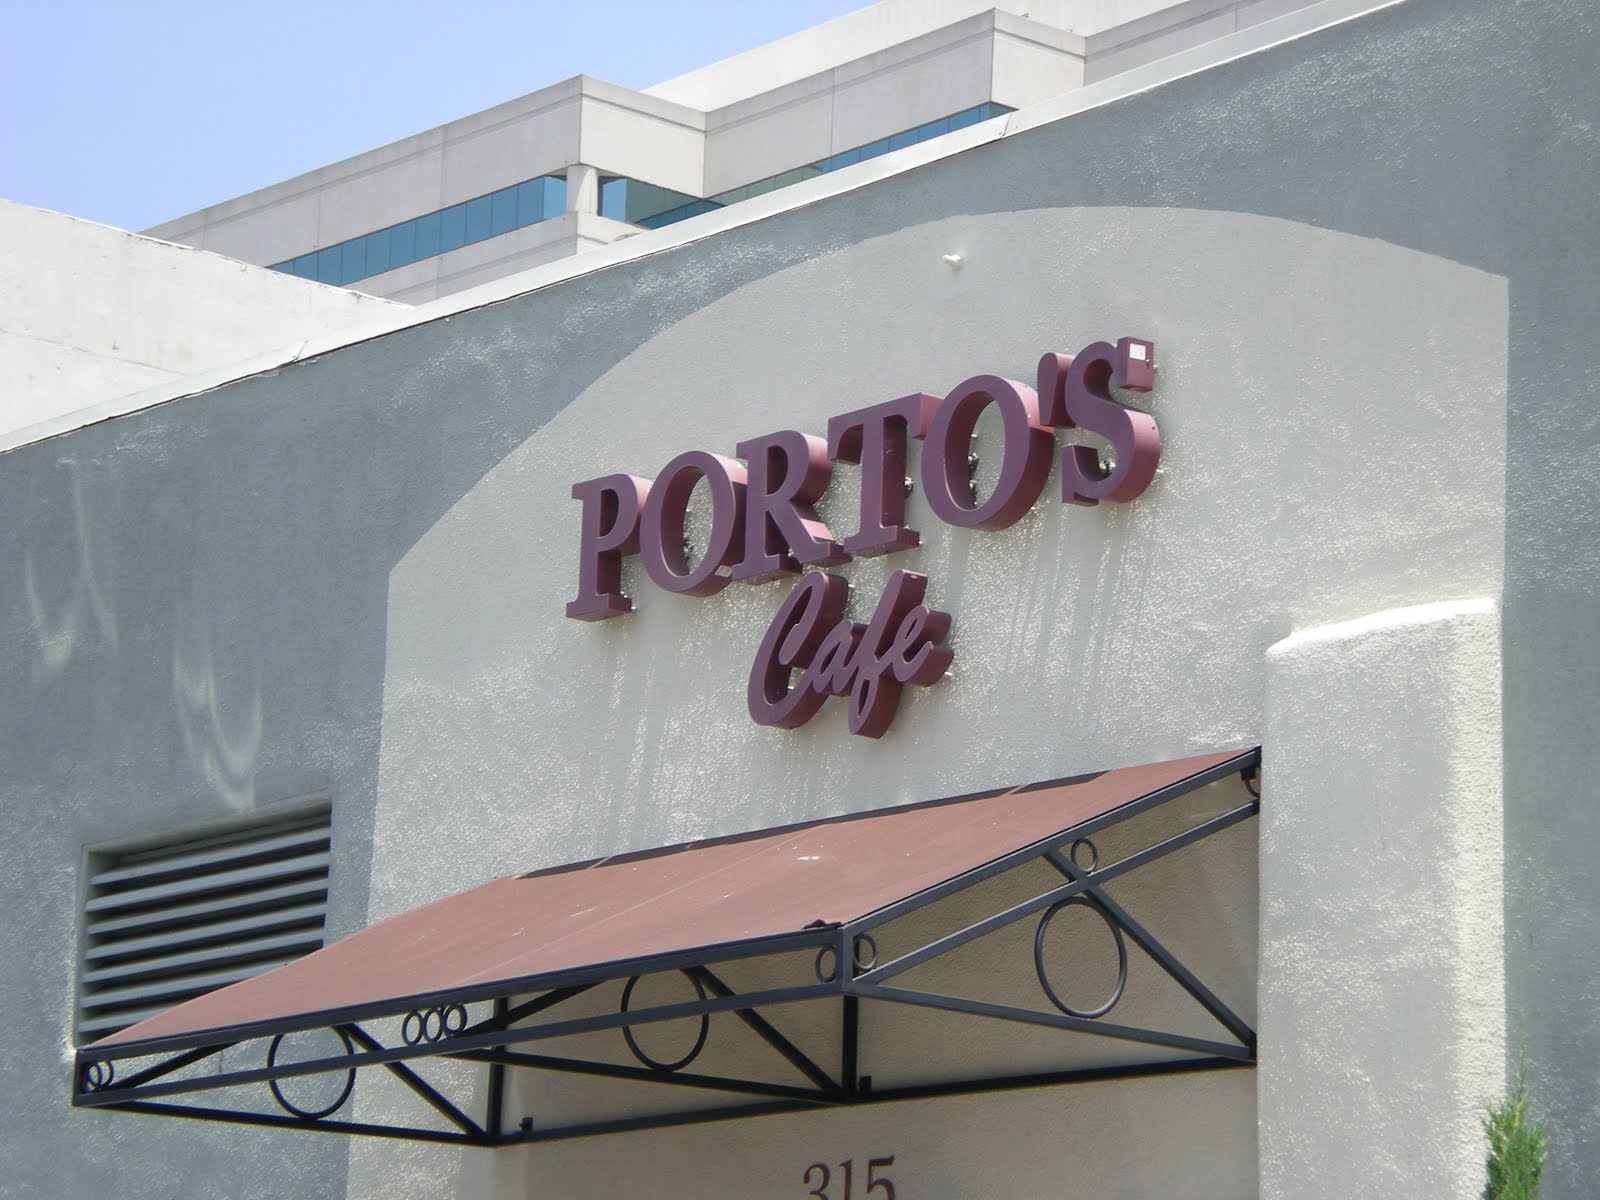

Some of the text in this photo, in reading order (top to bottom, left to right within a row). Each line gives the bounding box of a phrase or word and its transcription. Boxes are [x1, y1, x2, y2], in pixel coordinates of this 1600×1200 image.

[566, 336, 1161, 621] PORTO'S
[748, 569, 954, 738] Cafe
[803, 1155, 896, 1200] 315
